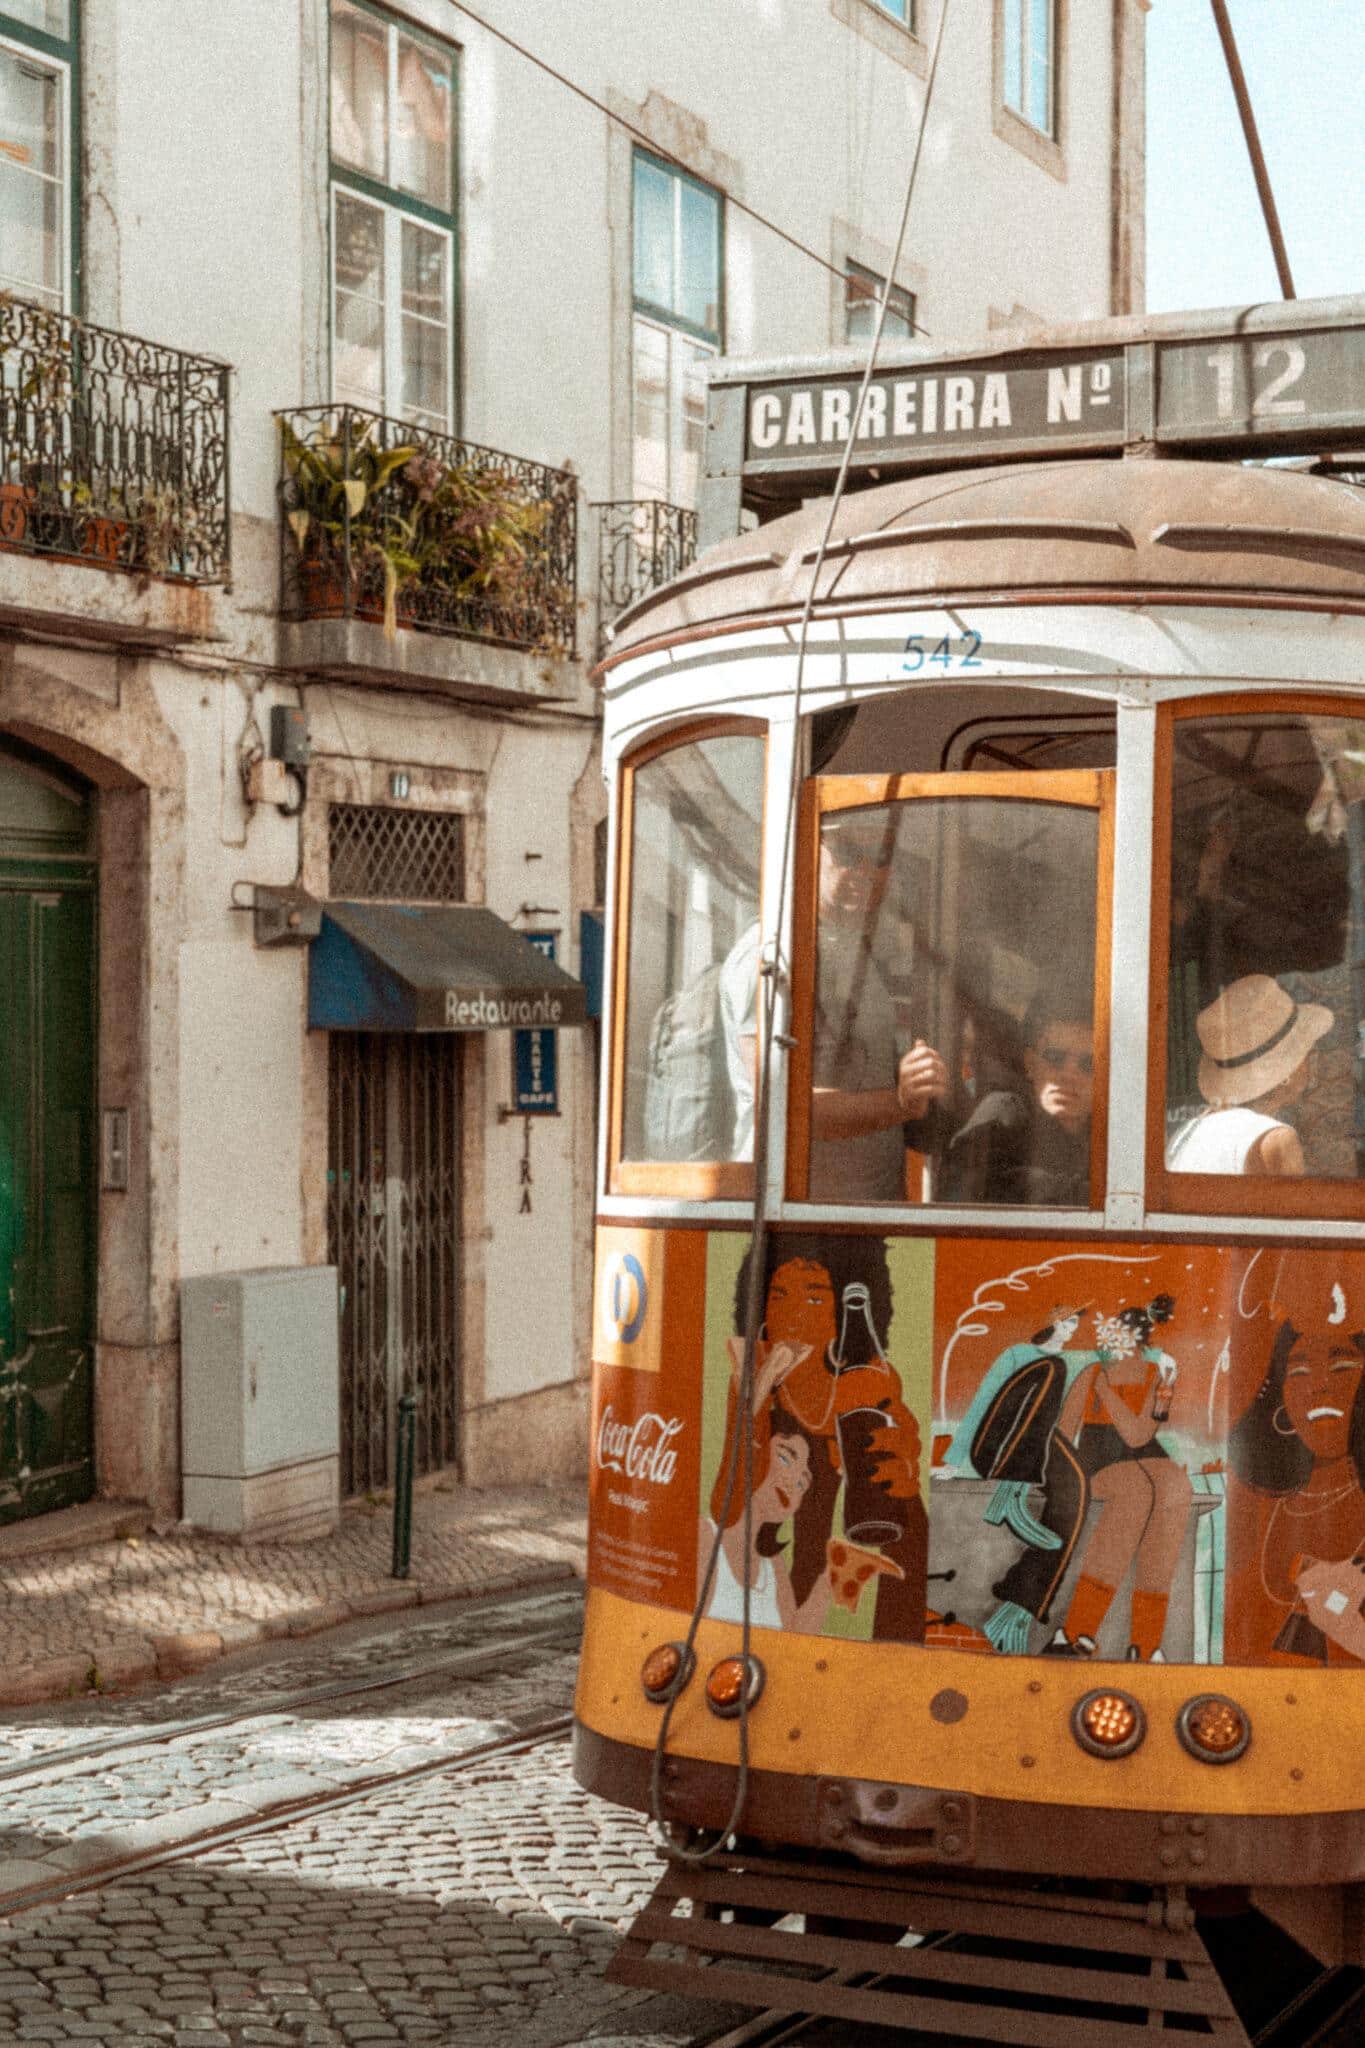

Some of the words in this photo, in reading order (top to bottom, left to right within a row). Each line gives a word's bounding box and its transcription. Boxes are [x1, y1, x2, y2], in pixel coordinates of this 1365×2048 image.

[751, 373, 1012, 449] CARREIRA
[1207, 341, 1305, 416] 12
[902, 629, 982, 671] 542
[445, 990, 561, 1024] Restaurante
[597, 1404, 686, 1485] Coca-Cola
